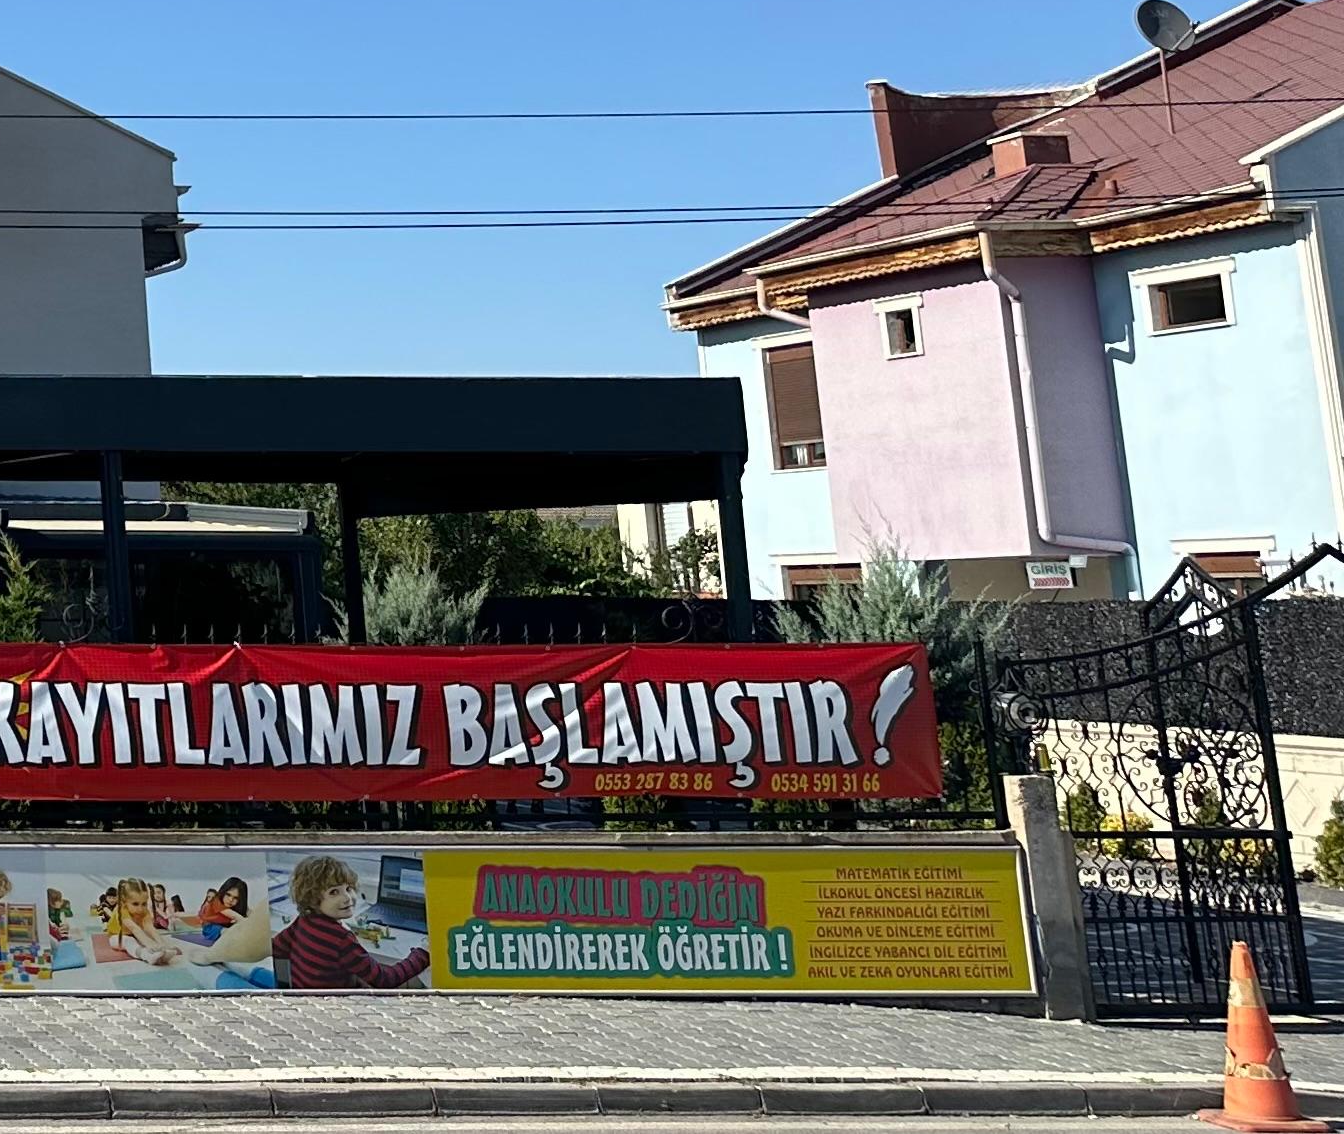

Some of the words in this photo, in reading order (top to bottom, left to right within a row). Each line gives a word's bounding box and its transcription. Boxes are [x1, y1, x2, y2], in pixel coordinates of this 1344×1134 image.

[595, 773, 631, 791] 0553
[635, 772, 662, 791] 287
[669, 772, 689, 790] 83
[693, 773, 713, 791] 86
[771, 773, 809, 792] 0534
[813, 773, 837, 792] 591
[841, 773, 858, 792] 31
[863, 773, 880, 792] 66
[836, 866, 911, 880] MATEMATİK
[914, 866, 962, 880] EĞİTİMİ
[482, 873, 629, 918] ANAOKULU
[640, 873, 759, 922] DEDİĞİN
[818, 885, 871, 899] İLKOKUL
[925, 887, 985, 899] HAZIRLIK
[816, 906, 845, 918] YAZI
[849, 904, 938, 918] FARKINDALIĞI
[941, 904, 990, 919] EĞİTİMİ
[816, 926, 863, 938] OKUMA
[866, 926, 883, 938] VE
[886, 924, 942, 938] DİNLEME
[946, 924, 995, 938] EĞİTİMİ
[454, 925, 650, 971] EĞLENDİREREK
[657, 925, 771, 971] ÖĞRETİR
[777, 933, 788, 970] !
[809, 944, 871, 959] İNGİLİZCE
[874, 946, 930, 959] YABANCI
[934, 944, 955, 958] DİL
[958, 944, 1007, 959] EĞİTİMİ
[808, 966, 837, 978] AKIL
[859, 966, 892, 978] ZEKA
[896, 966, 961, 979] OYUNLARI
[964, 964, 1014, 979] EĞİTİMİ
